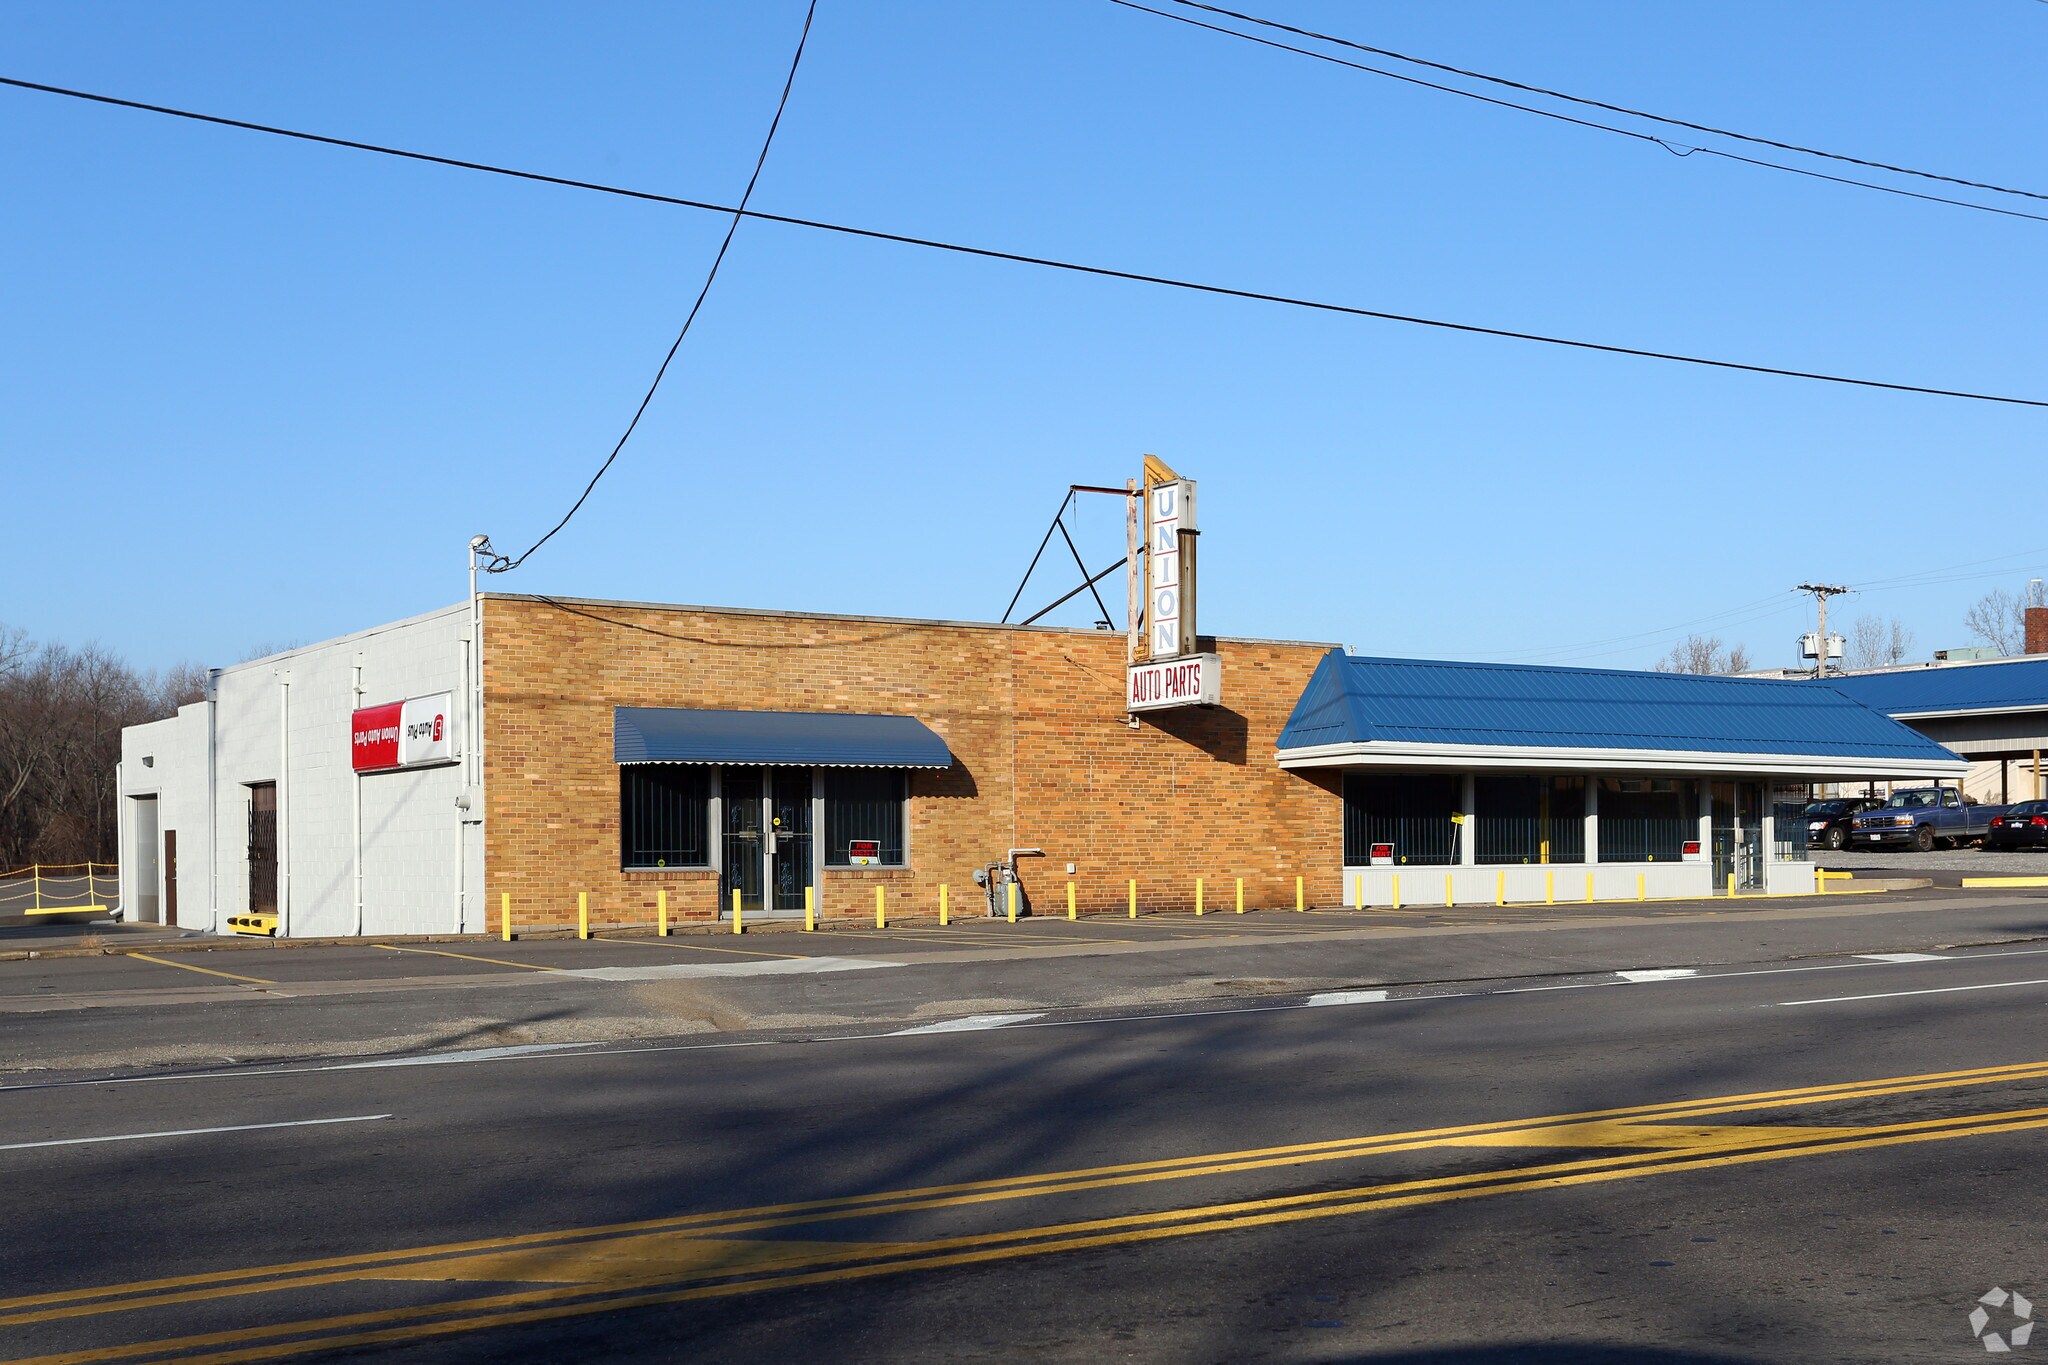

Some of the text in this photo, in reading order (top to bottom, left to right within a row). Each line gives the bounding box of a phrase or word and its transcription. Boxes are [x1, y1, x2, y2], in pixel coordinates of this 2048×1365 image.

[1157, 489, 1176, 650] UNION
[1132, 663, 1201, 703] AUTO PARTS
[354, 726, 399, 747] Union Auto Parts
[407, 720, 433, 741] Auto Plus
